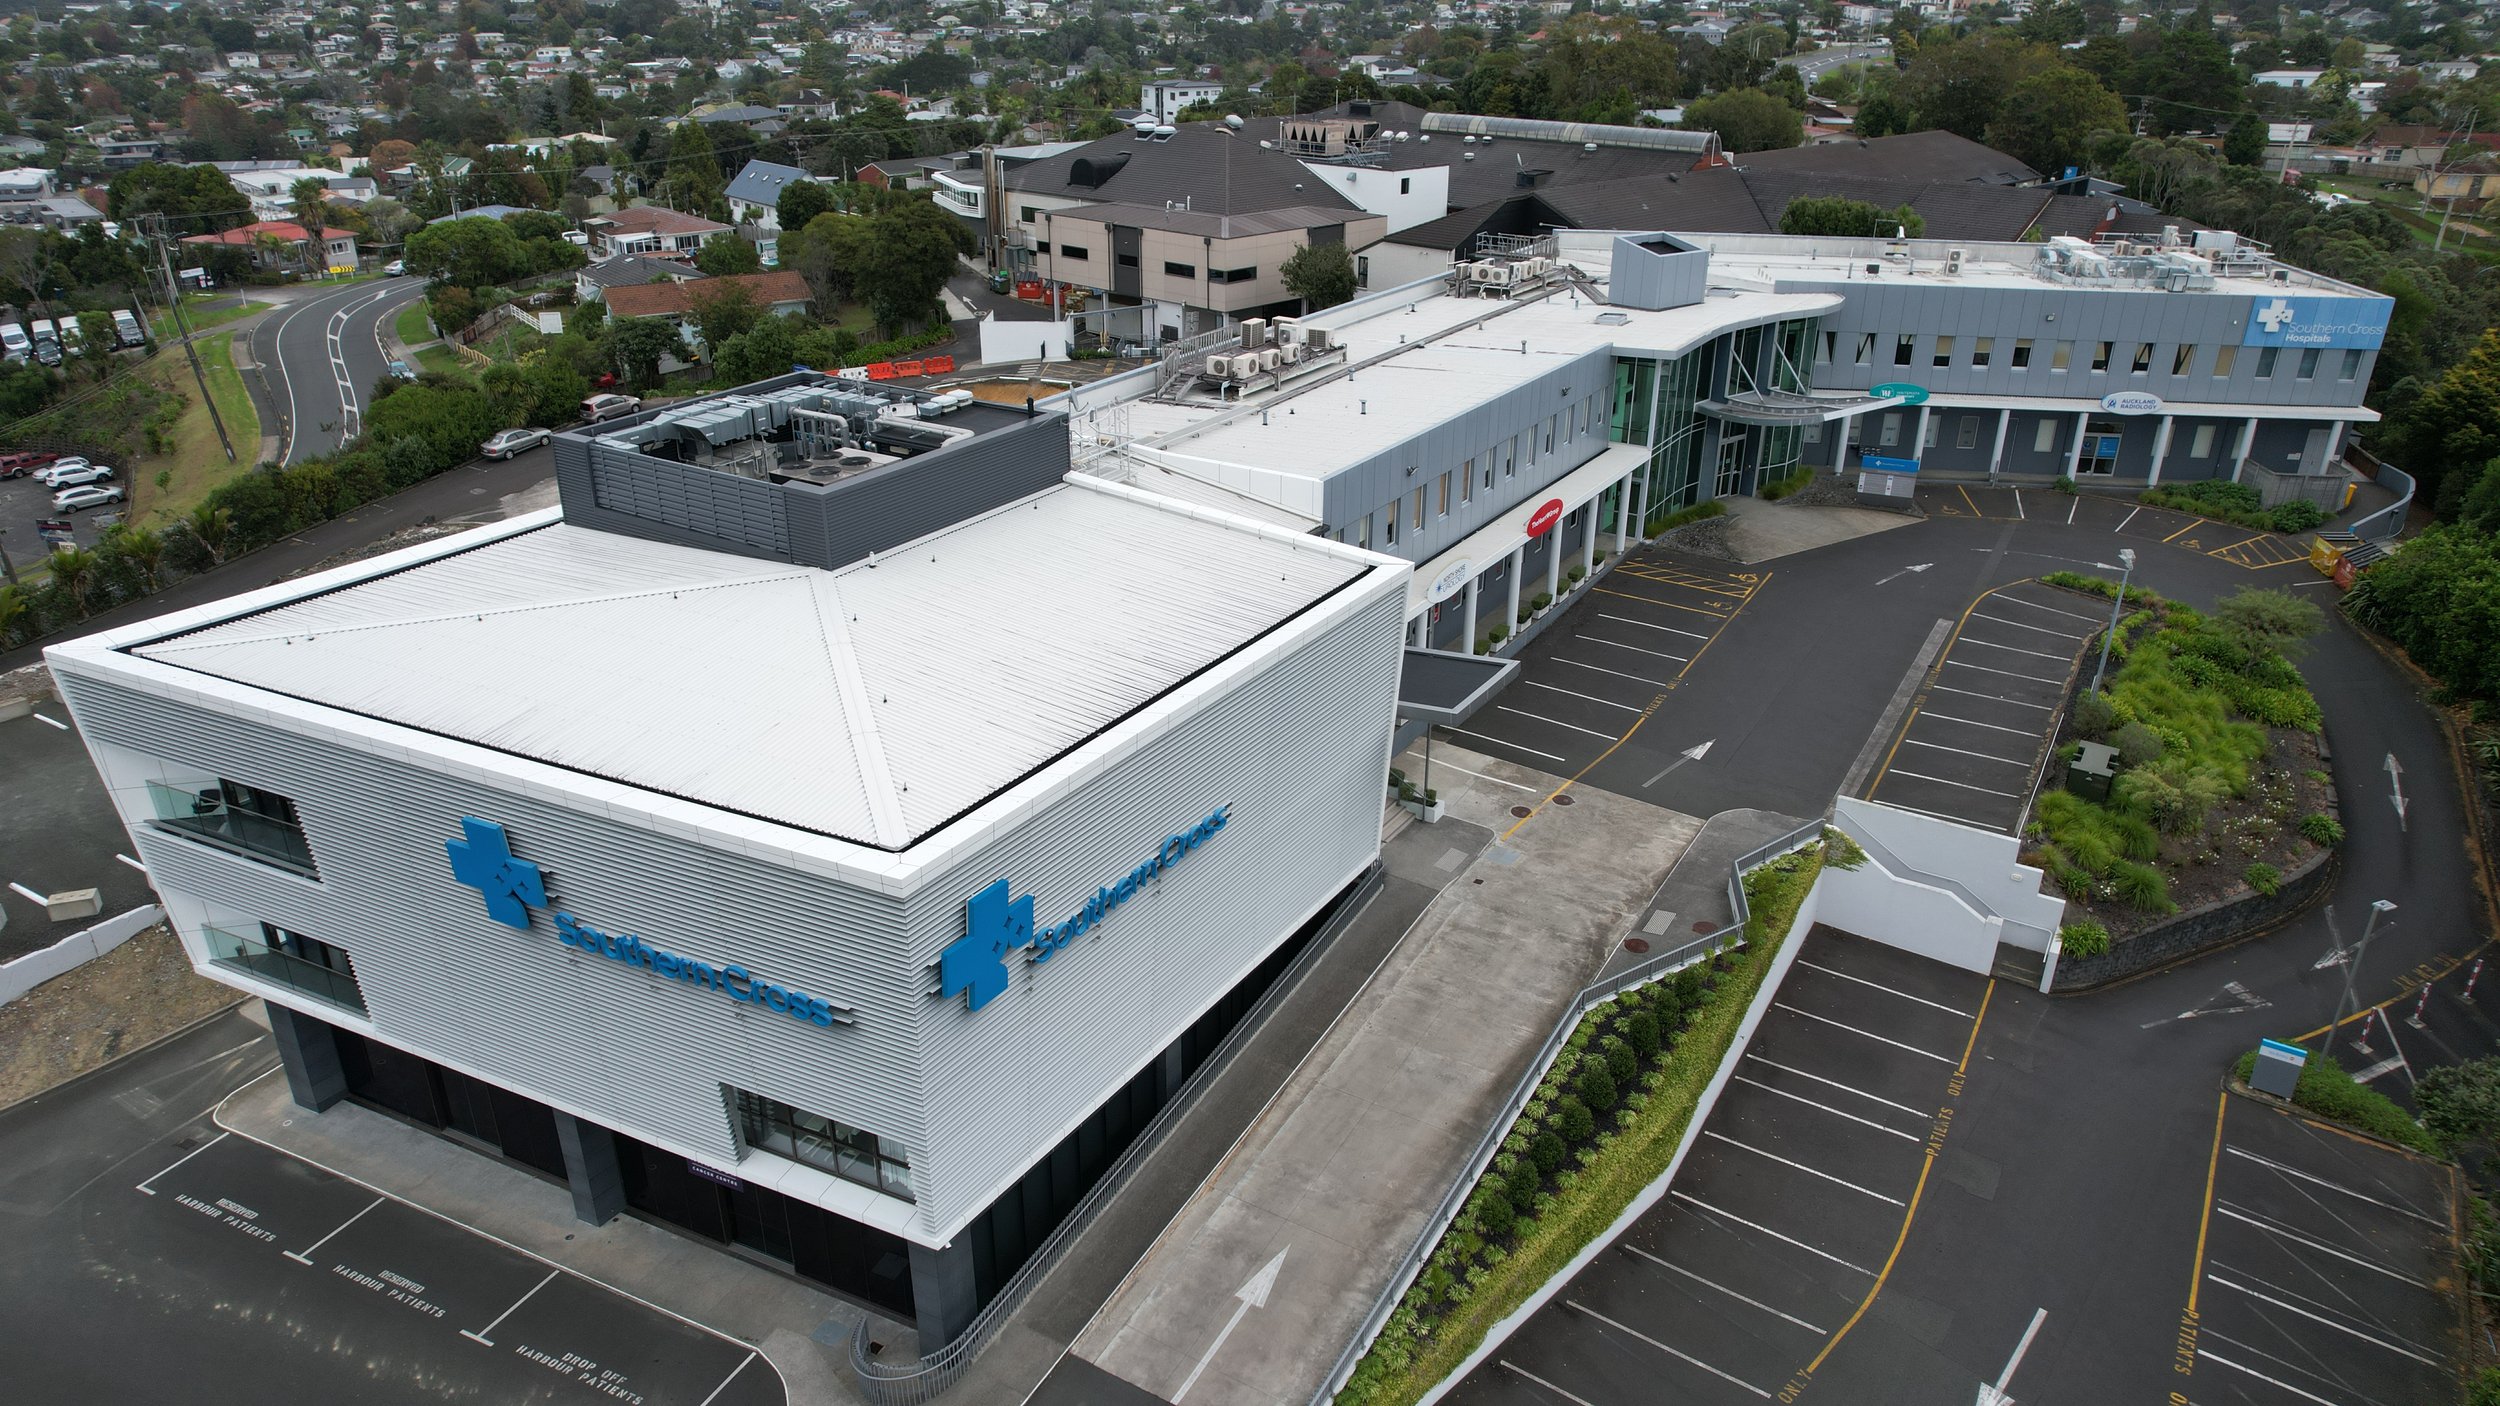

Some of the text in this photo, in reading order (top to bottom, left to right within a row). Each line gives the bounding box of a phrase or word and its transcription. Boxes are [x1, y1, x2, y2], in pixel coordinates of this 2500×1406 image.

[2285, 333, 2331, 344] Hospitals
[2287, 322, 2384, 335] Southern Cross
[1033, 806, 1228, 964] Southern Cross
[553, 912, 834, 1028] Southern Cross
[1925, 1071, 1966, 1156] PATIENTS ONLY
[692, 1166, 738, 1187] CANCER CENTRE
[174, 1193, 277, 1242] HARBOUR PATIENTS
[215, 1197, 259, 1220] RESERVED
[332, 1264, 446, 1318] HARBOUR PATIENTS
[378, 1269, 426, 1294] RESERVED
[2174, 1307, 2200, 1376] PATIENTS
[515, 1344, 644, 1405] HARBOUR PATIENTS
[561, 1352, 628, 1384] DROP OFF
[1777, 1368, 1812, 1404] ONLY
